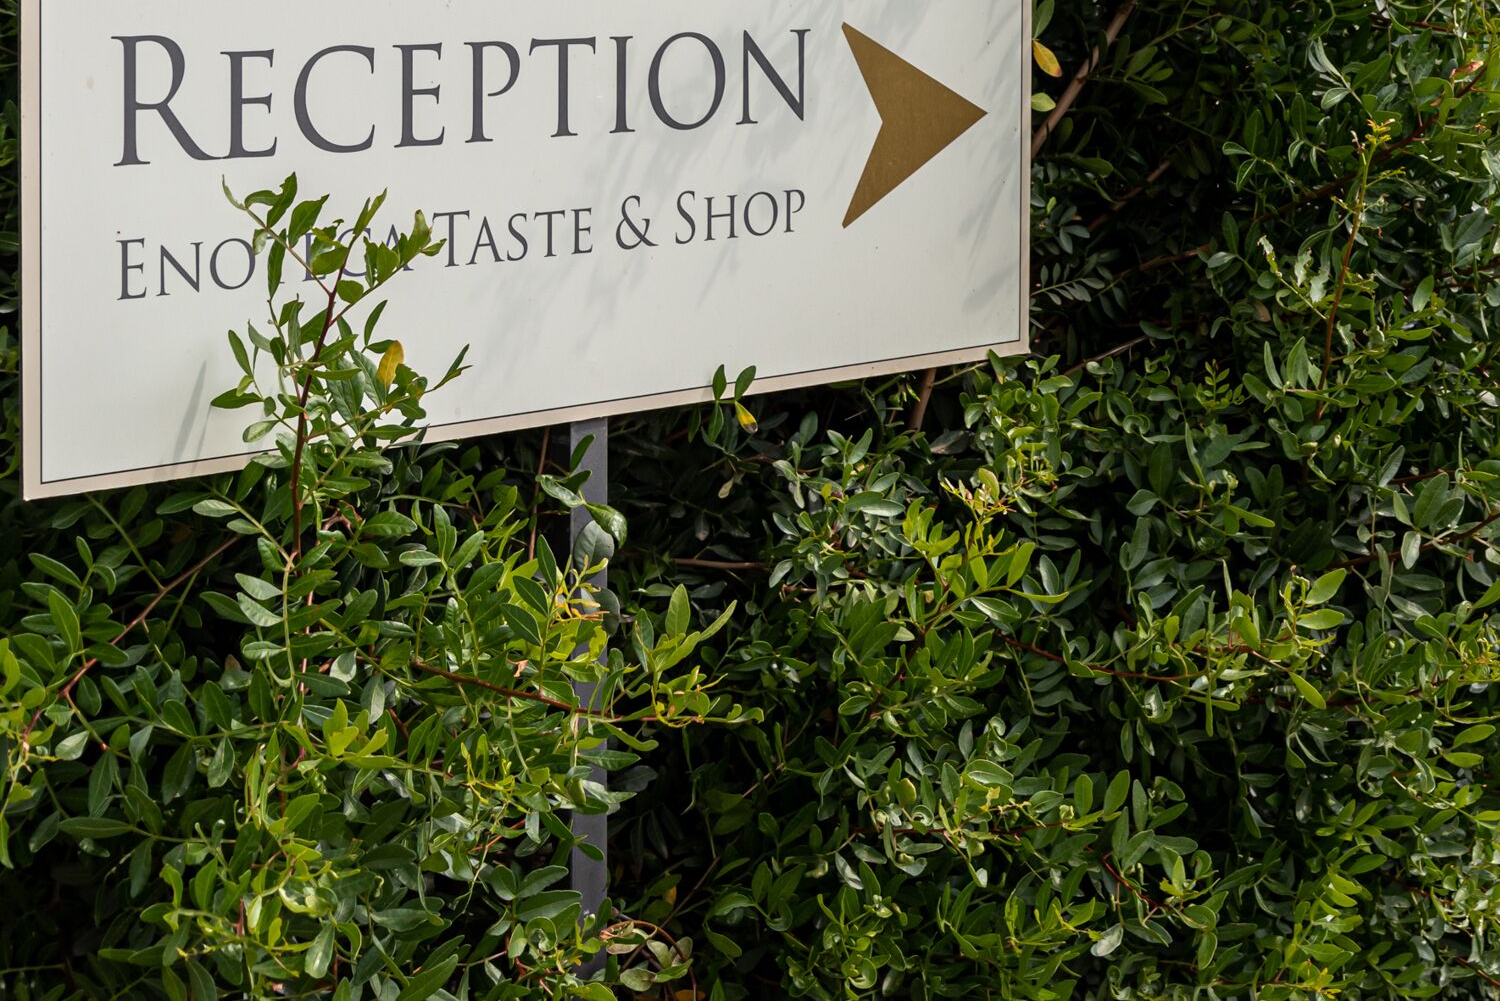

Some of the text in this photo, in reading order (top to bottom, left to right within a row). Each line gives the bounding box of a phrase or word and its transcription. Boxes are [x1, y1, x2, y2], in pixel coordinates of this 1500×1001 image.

[110, 28, 812, 167] RECEPTION
[115, 188, 806, 301] ENOEC TASTE & SHOP
